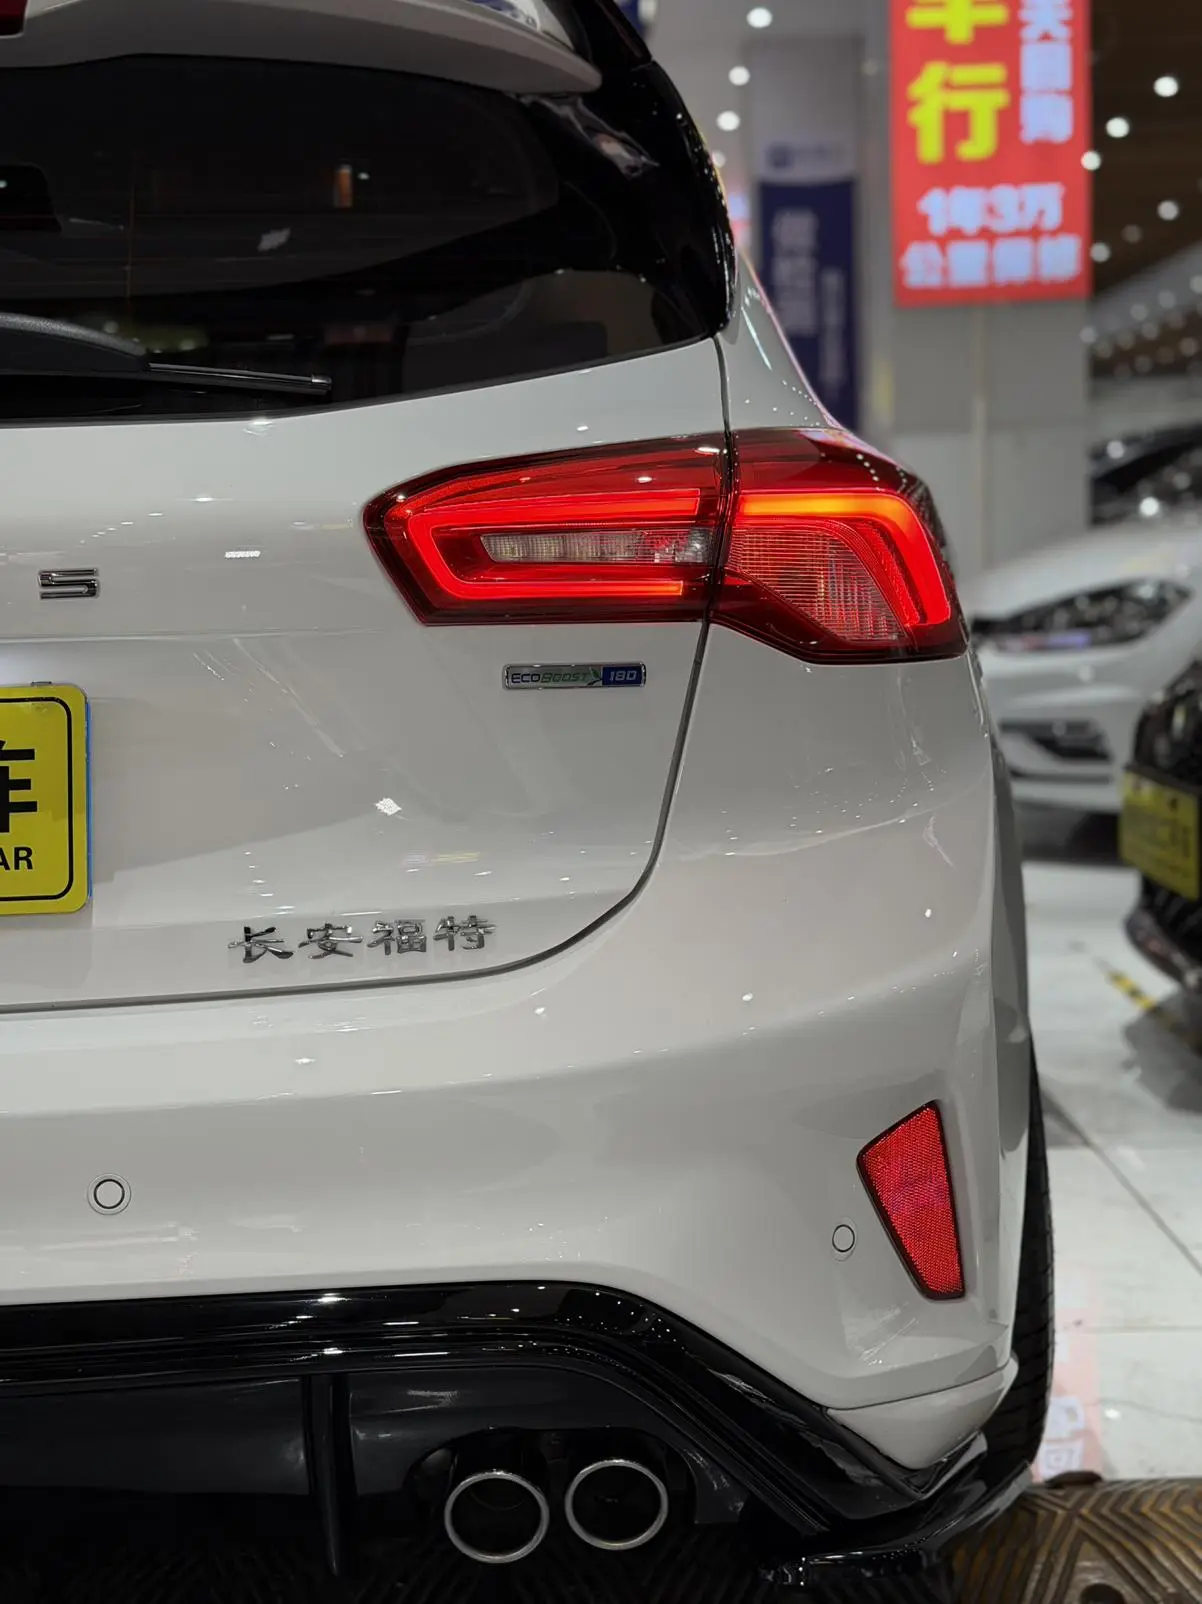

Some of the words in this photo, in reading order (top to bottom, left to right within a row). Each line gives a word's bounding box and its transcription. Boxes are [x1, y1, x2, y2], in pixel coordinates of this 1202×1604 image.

[38, 568, 98, 599] S
[609, 670, 637, 682] 180
[227, 915, 496, 963] 长安福特
